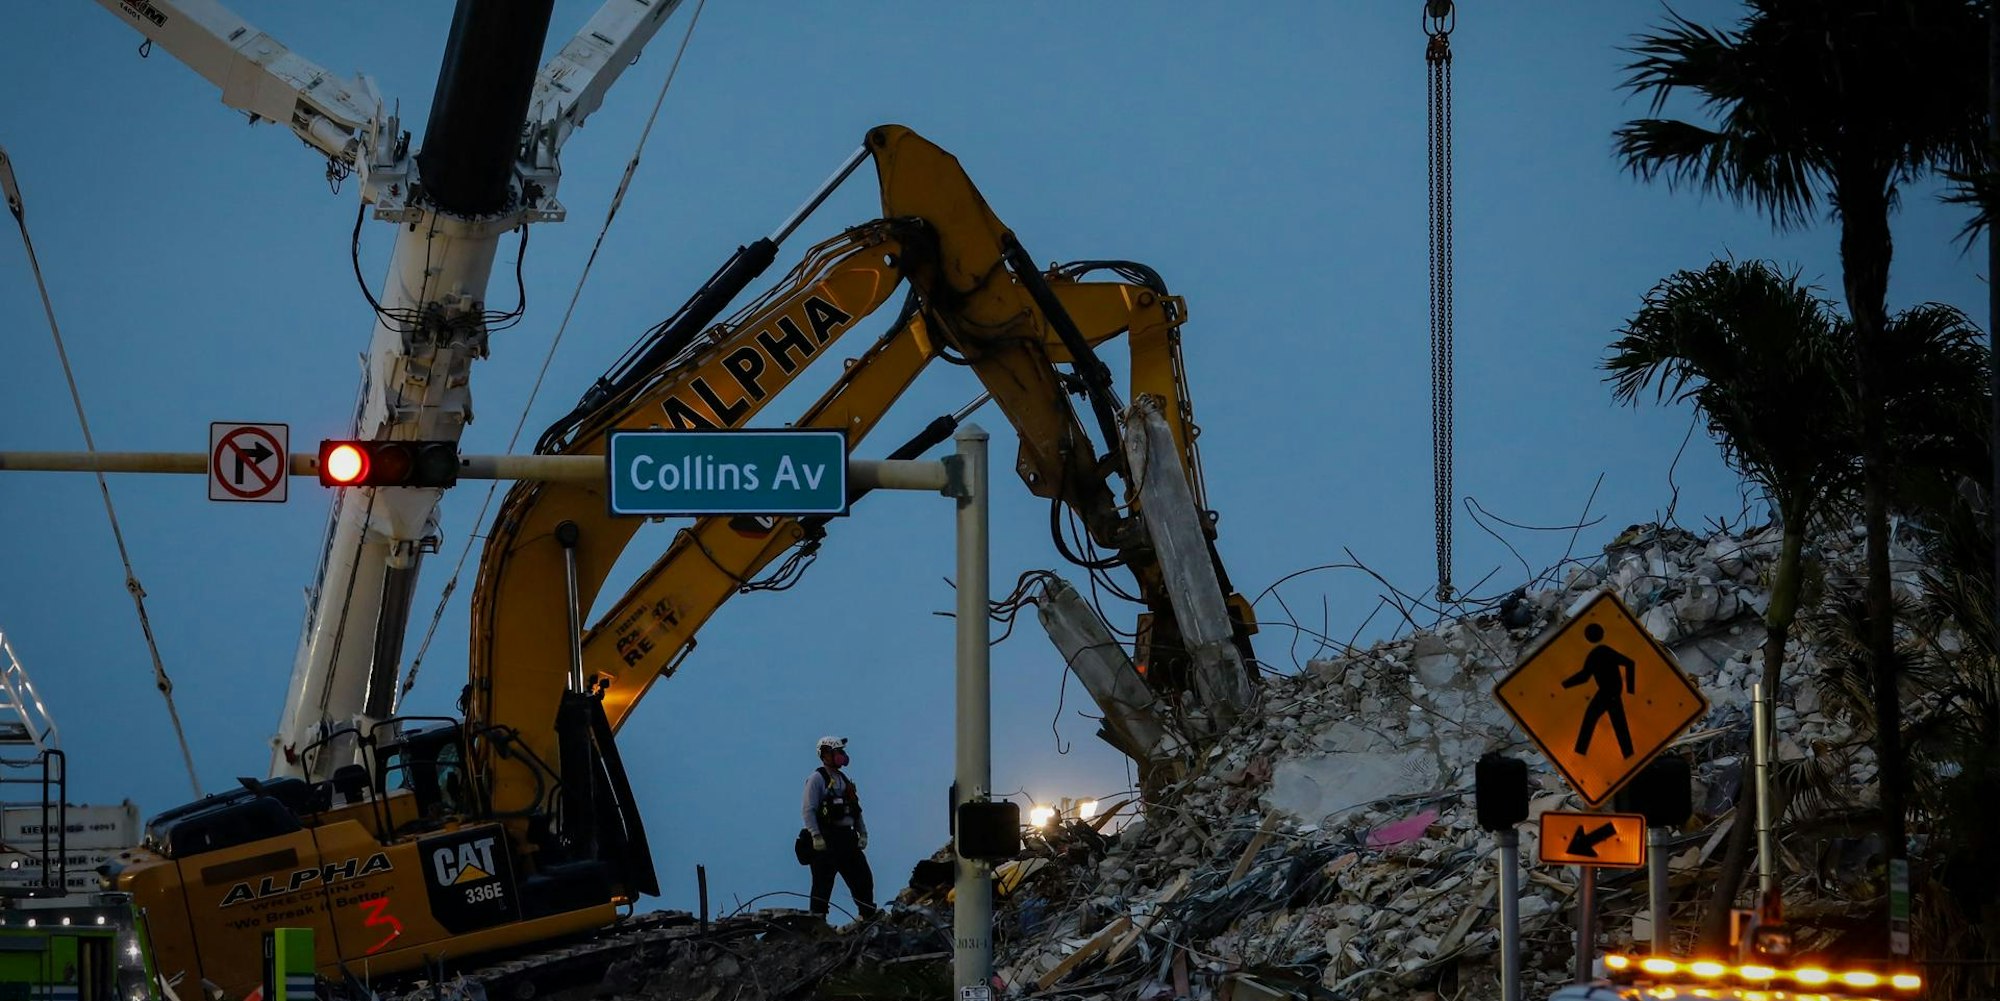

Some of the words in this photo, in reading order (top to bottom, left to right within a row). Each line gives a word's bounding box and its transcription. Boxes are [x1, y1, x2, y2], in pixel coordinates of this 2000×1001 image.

[661, 296, 853, 430] ALPHA
[630, 454, 760, 491] Collins
[771, 455, 826, 491] Av
[219, 852, 393, 908] ALPHA
[433, 837, 496, 887] CAT
[252, 882, 366, 910] WRECKING
[465, 882, 504, 904] 336E
[267, 905, 315, 923] Break
